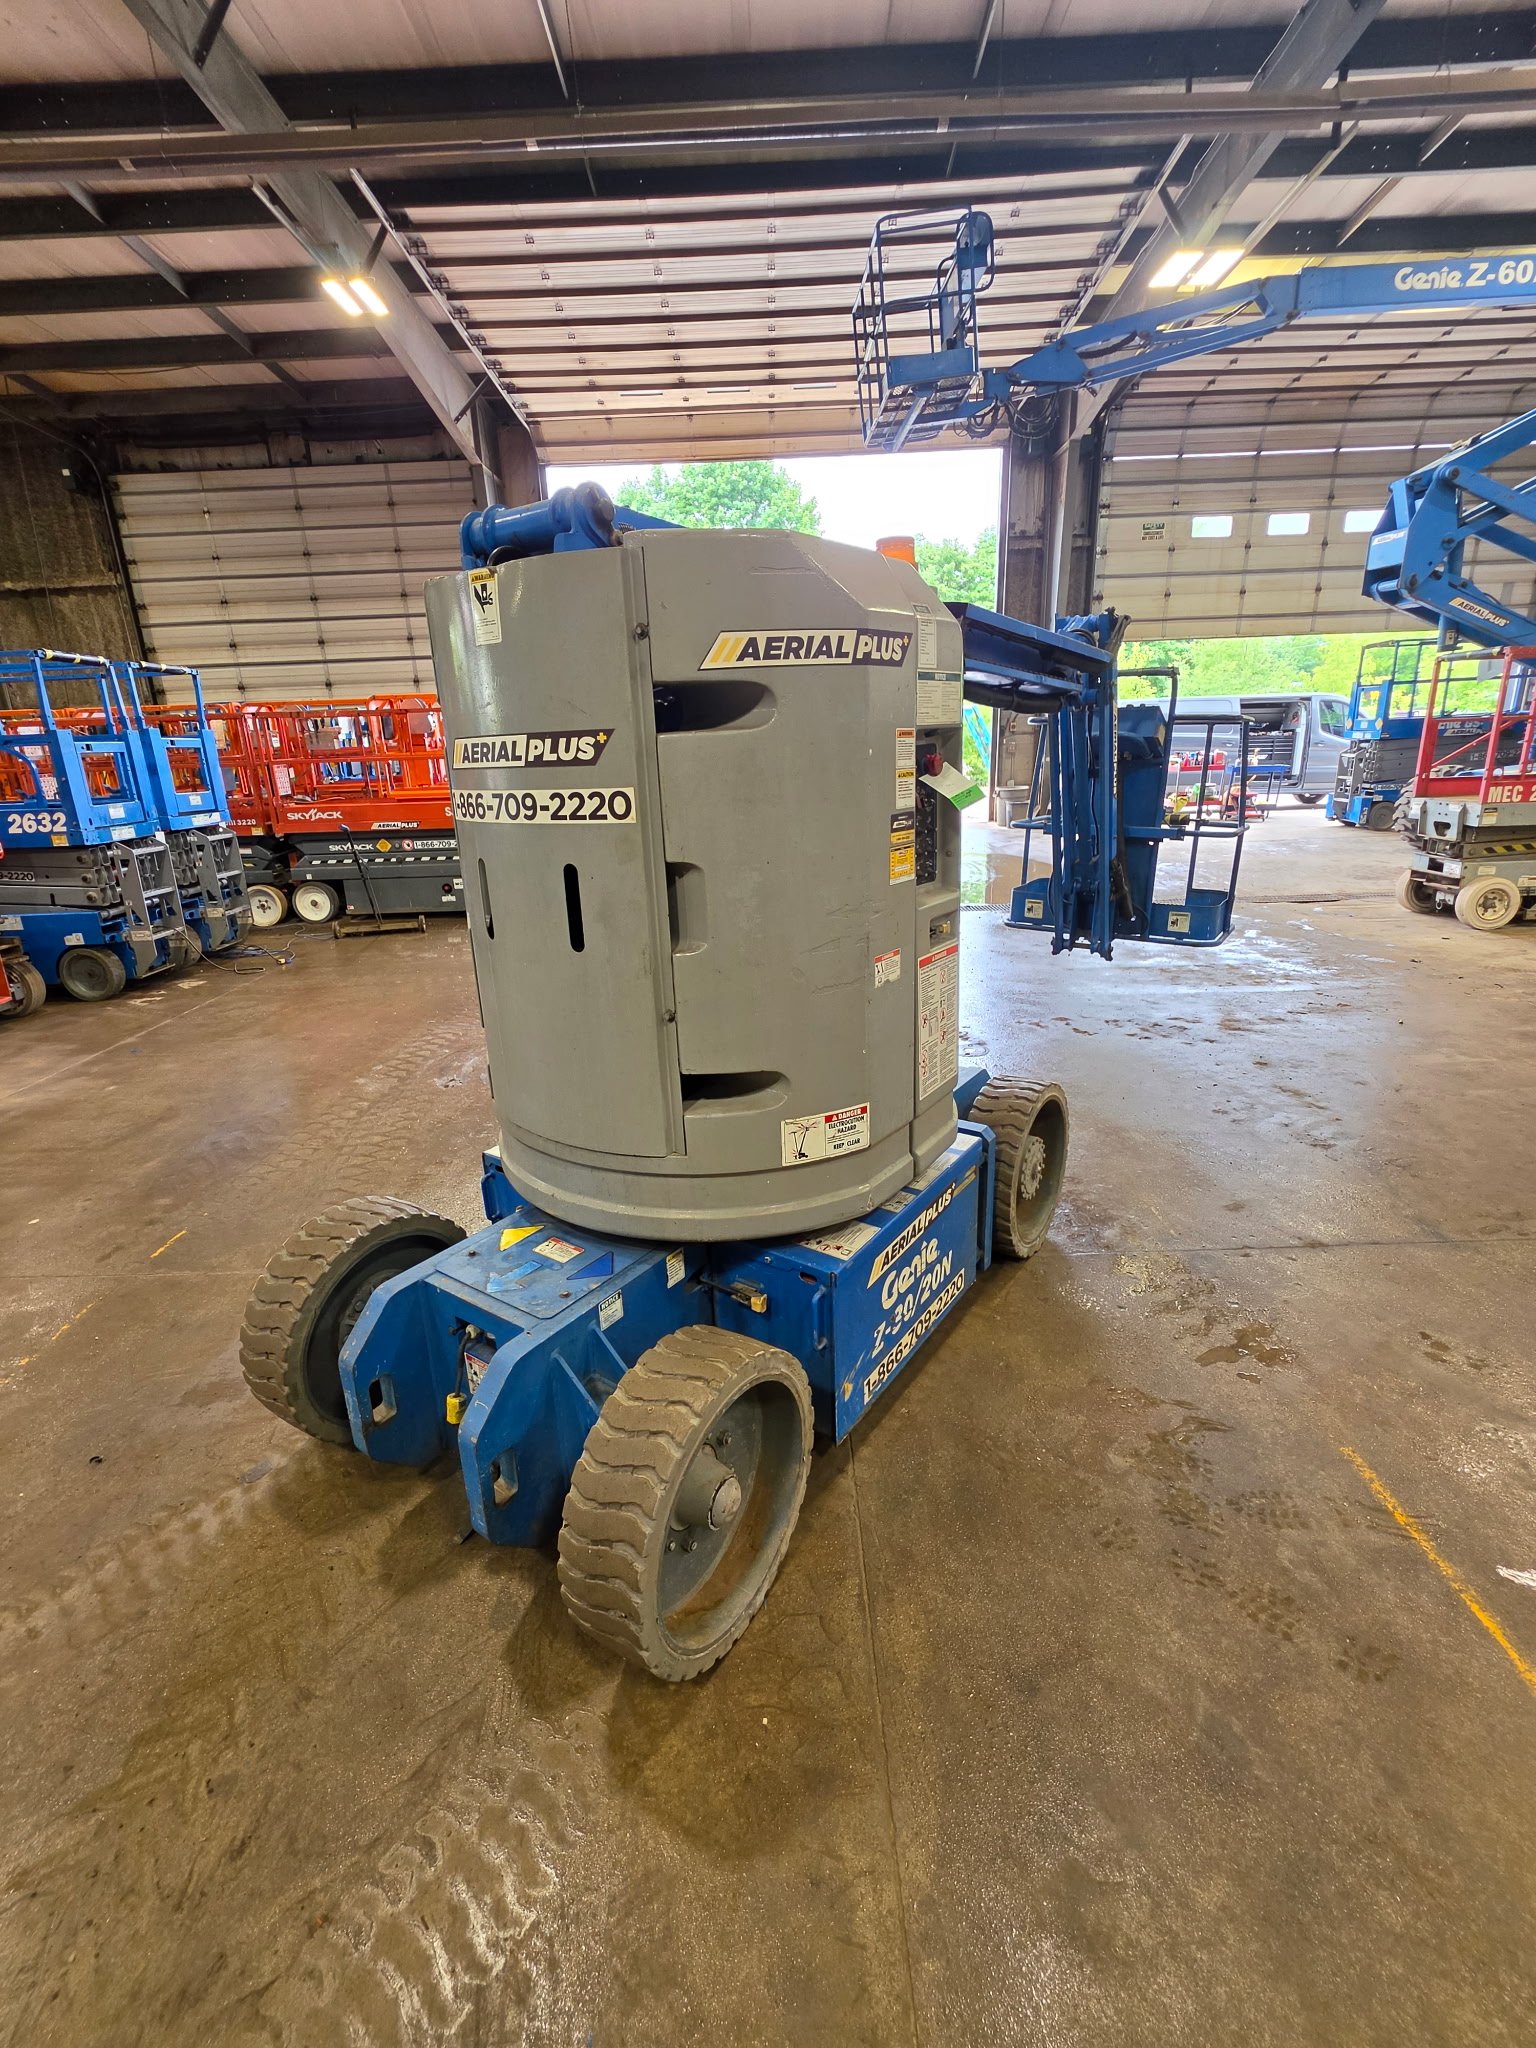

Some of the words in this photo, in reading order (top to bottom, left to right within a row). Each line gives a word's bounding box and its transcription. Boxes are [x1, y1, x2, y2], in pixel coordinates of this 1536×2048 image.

[1394, 265, 1463, 291] Genie
[1465, 259, 1536, 288] Z-60
[1457, 600, 1487, 620] AERIAL
[736, 634, 851, 662] AERIAL
[462, 740, 523, 764] AERIAL
[1487, 784, 1524, 803] MEC
[286, 808, 343, 821] SKYJACK
[452, 790, 632, 821] 1-866-709-2220
[7, 811, 68, 834] 2632
[237, 818, 257, 827] 3220
[828, 1115, 865, 1130] ELECTROCUTION
[838, 1108, 862, 1120] DANGER
[837, 1124, 857, 1134] HAZARD
[833, 1142, 845, 1150] KEEP
[846, 1138, 861, 1148] CLEAR
[880, 1221, 924, 1272] AERIAL
[881, 1237, 940, 1310] Genie
[864, 1272, 964, 1398] 1-866-709-2220
